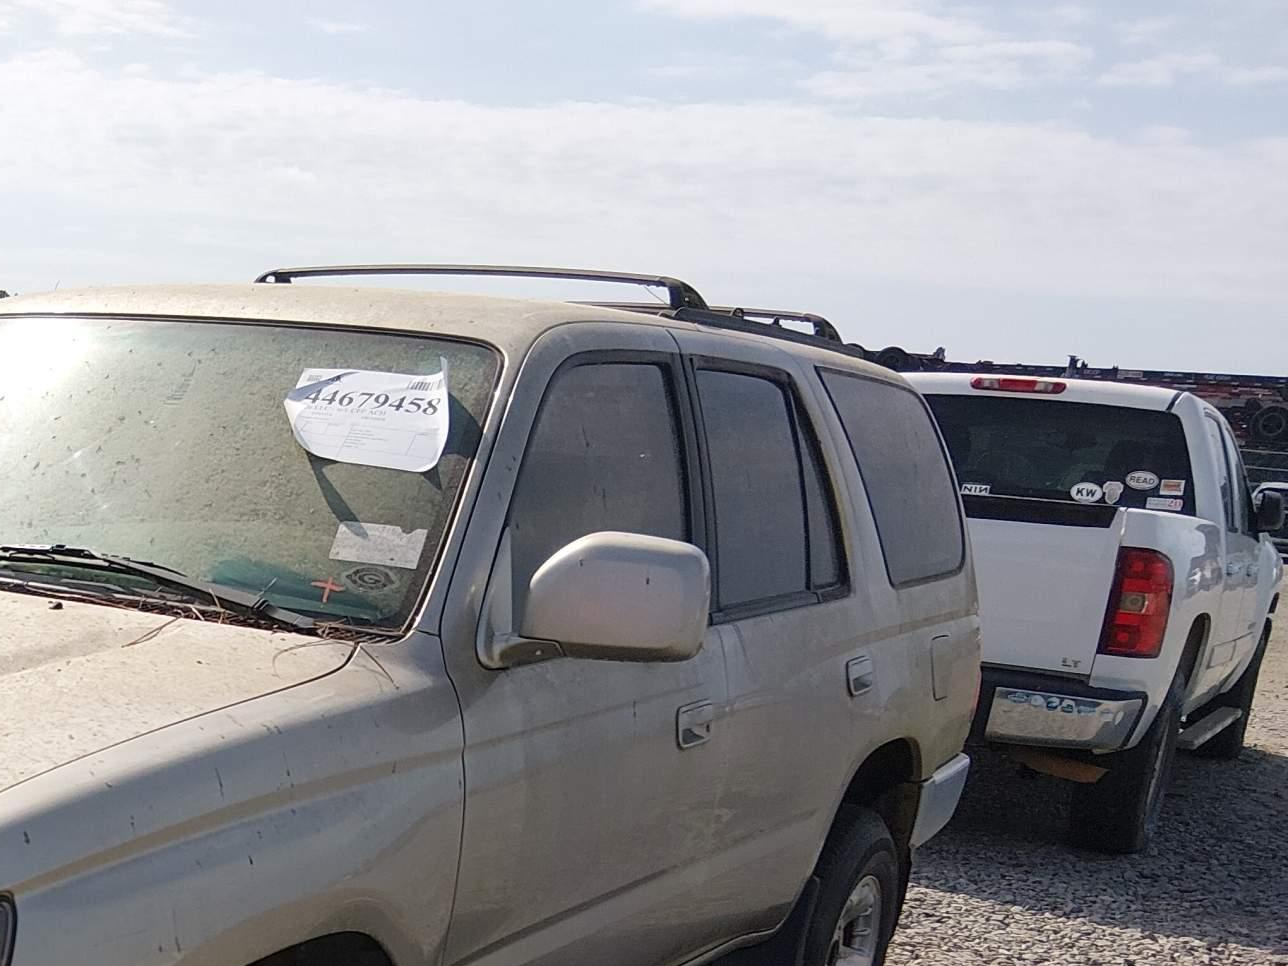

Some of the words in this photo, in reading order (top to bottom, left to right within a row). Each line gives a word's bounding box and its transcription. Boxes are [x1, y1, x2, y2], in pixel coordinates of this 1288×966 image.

[305, 388, 442, 416] 44679458
[1129, 475, 1155, 486] READ
[1075, 487, 1097, 498] KW
[1062, 657, 1081, 668] LT
